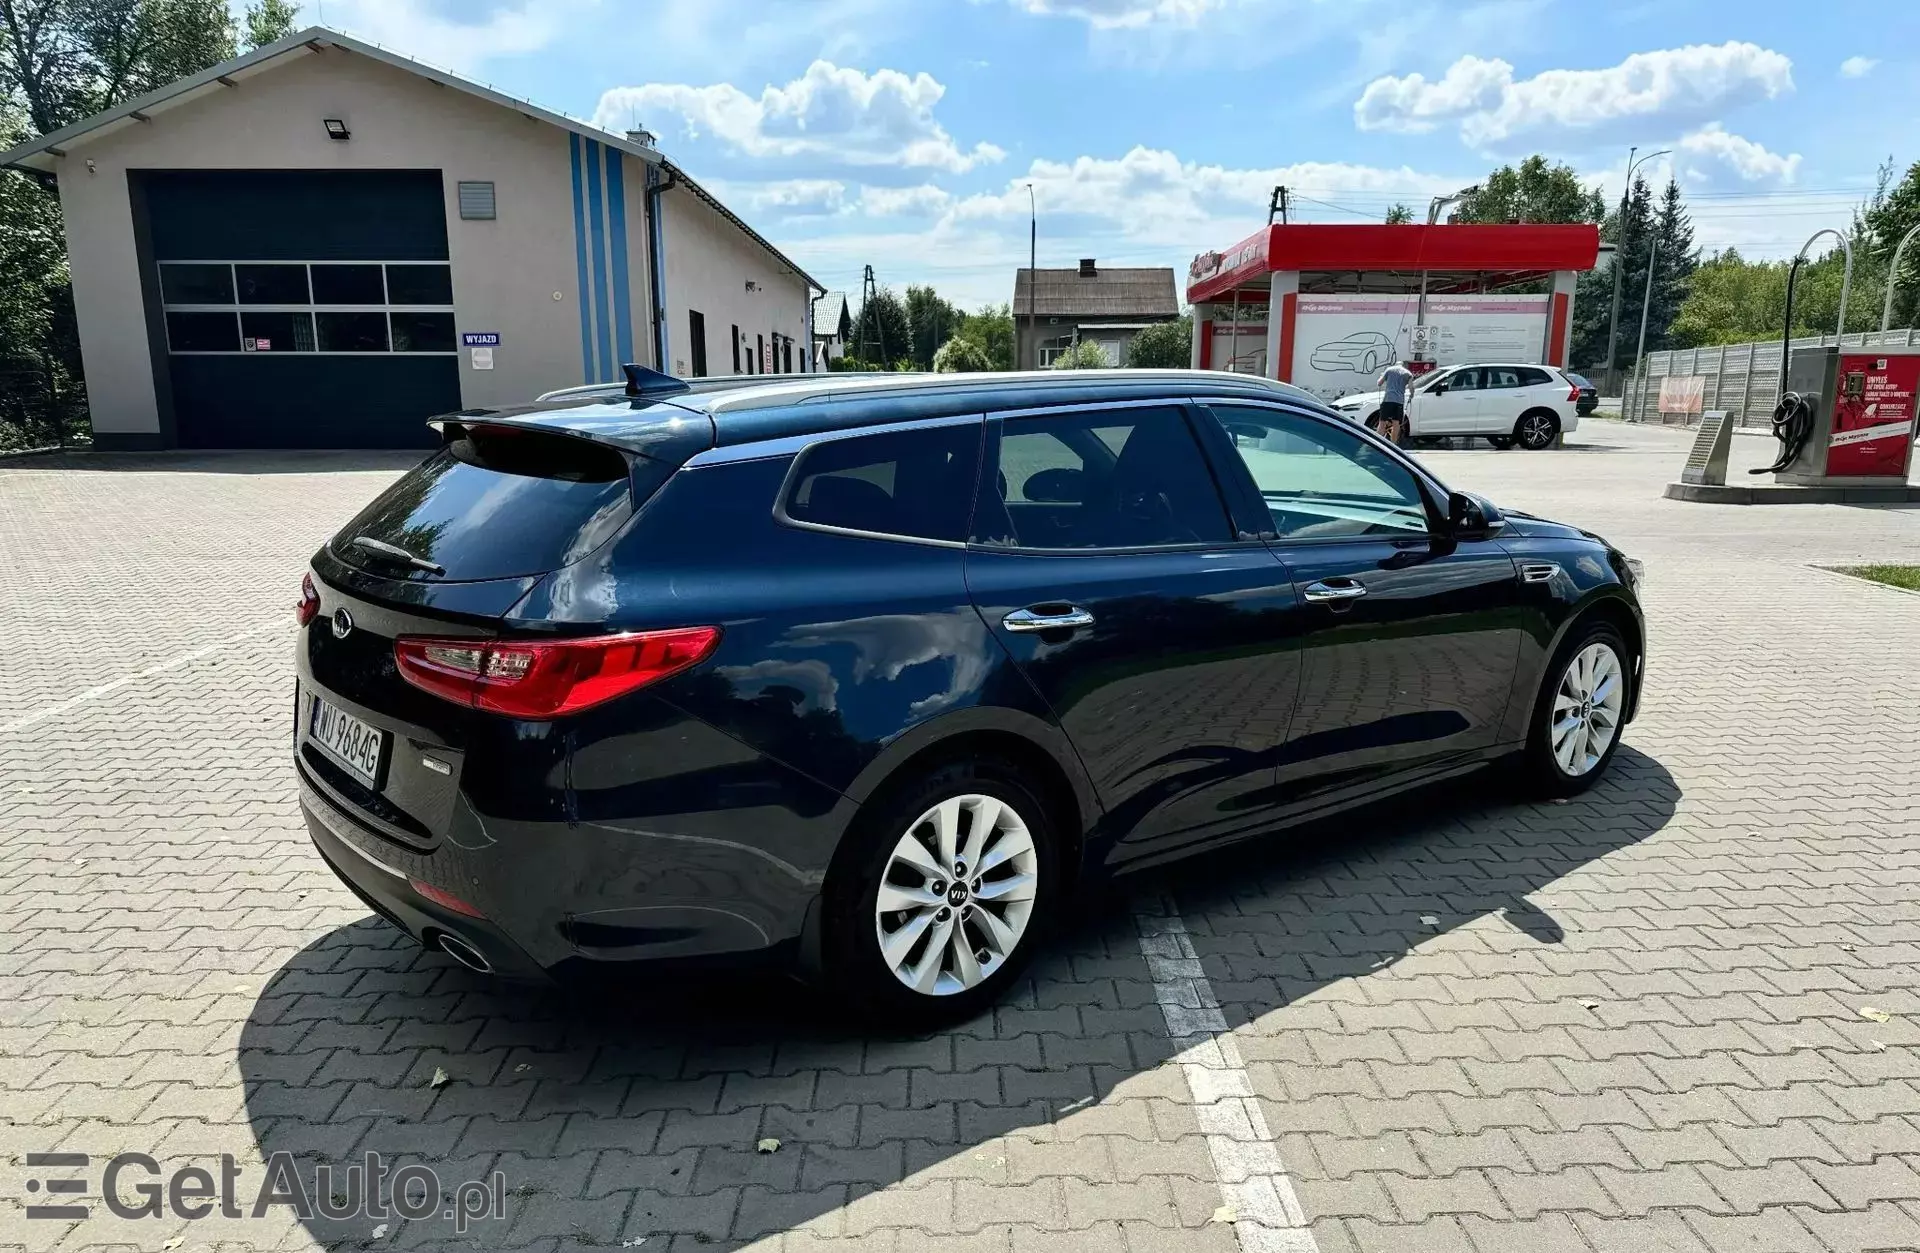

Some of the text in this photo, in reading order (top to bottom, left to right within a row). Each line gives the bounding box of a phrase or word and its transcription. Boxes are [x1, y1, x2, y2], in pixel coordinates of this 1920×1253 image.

[466, 335, 496, 343] WYJAZD
[320, 702, 337, 742] WU
[335, 714, 379, 773] 9684G
[951, 890, 967, 900] KIA
